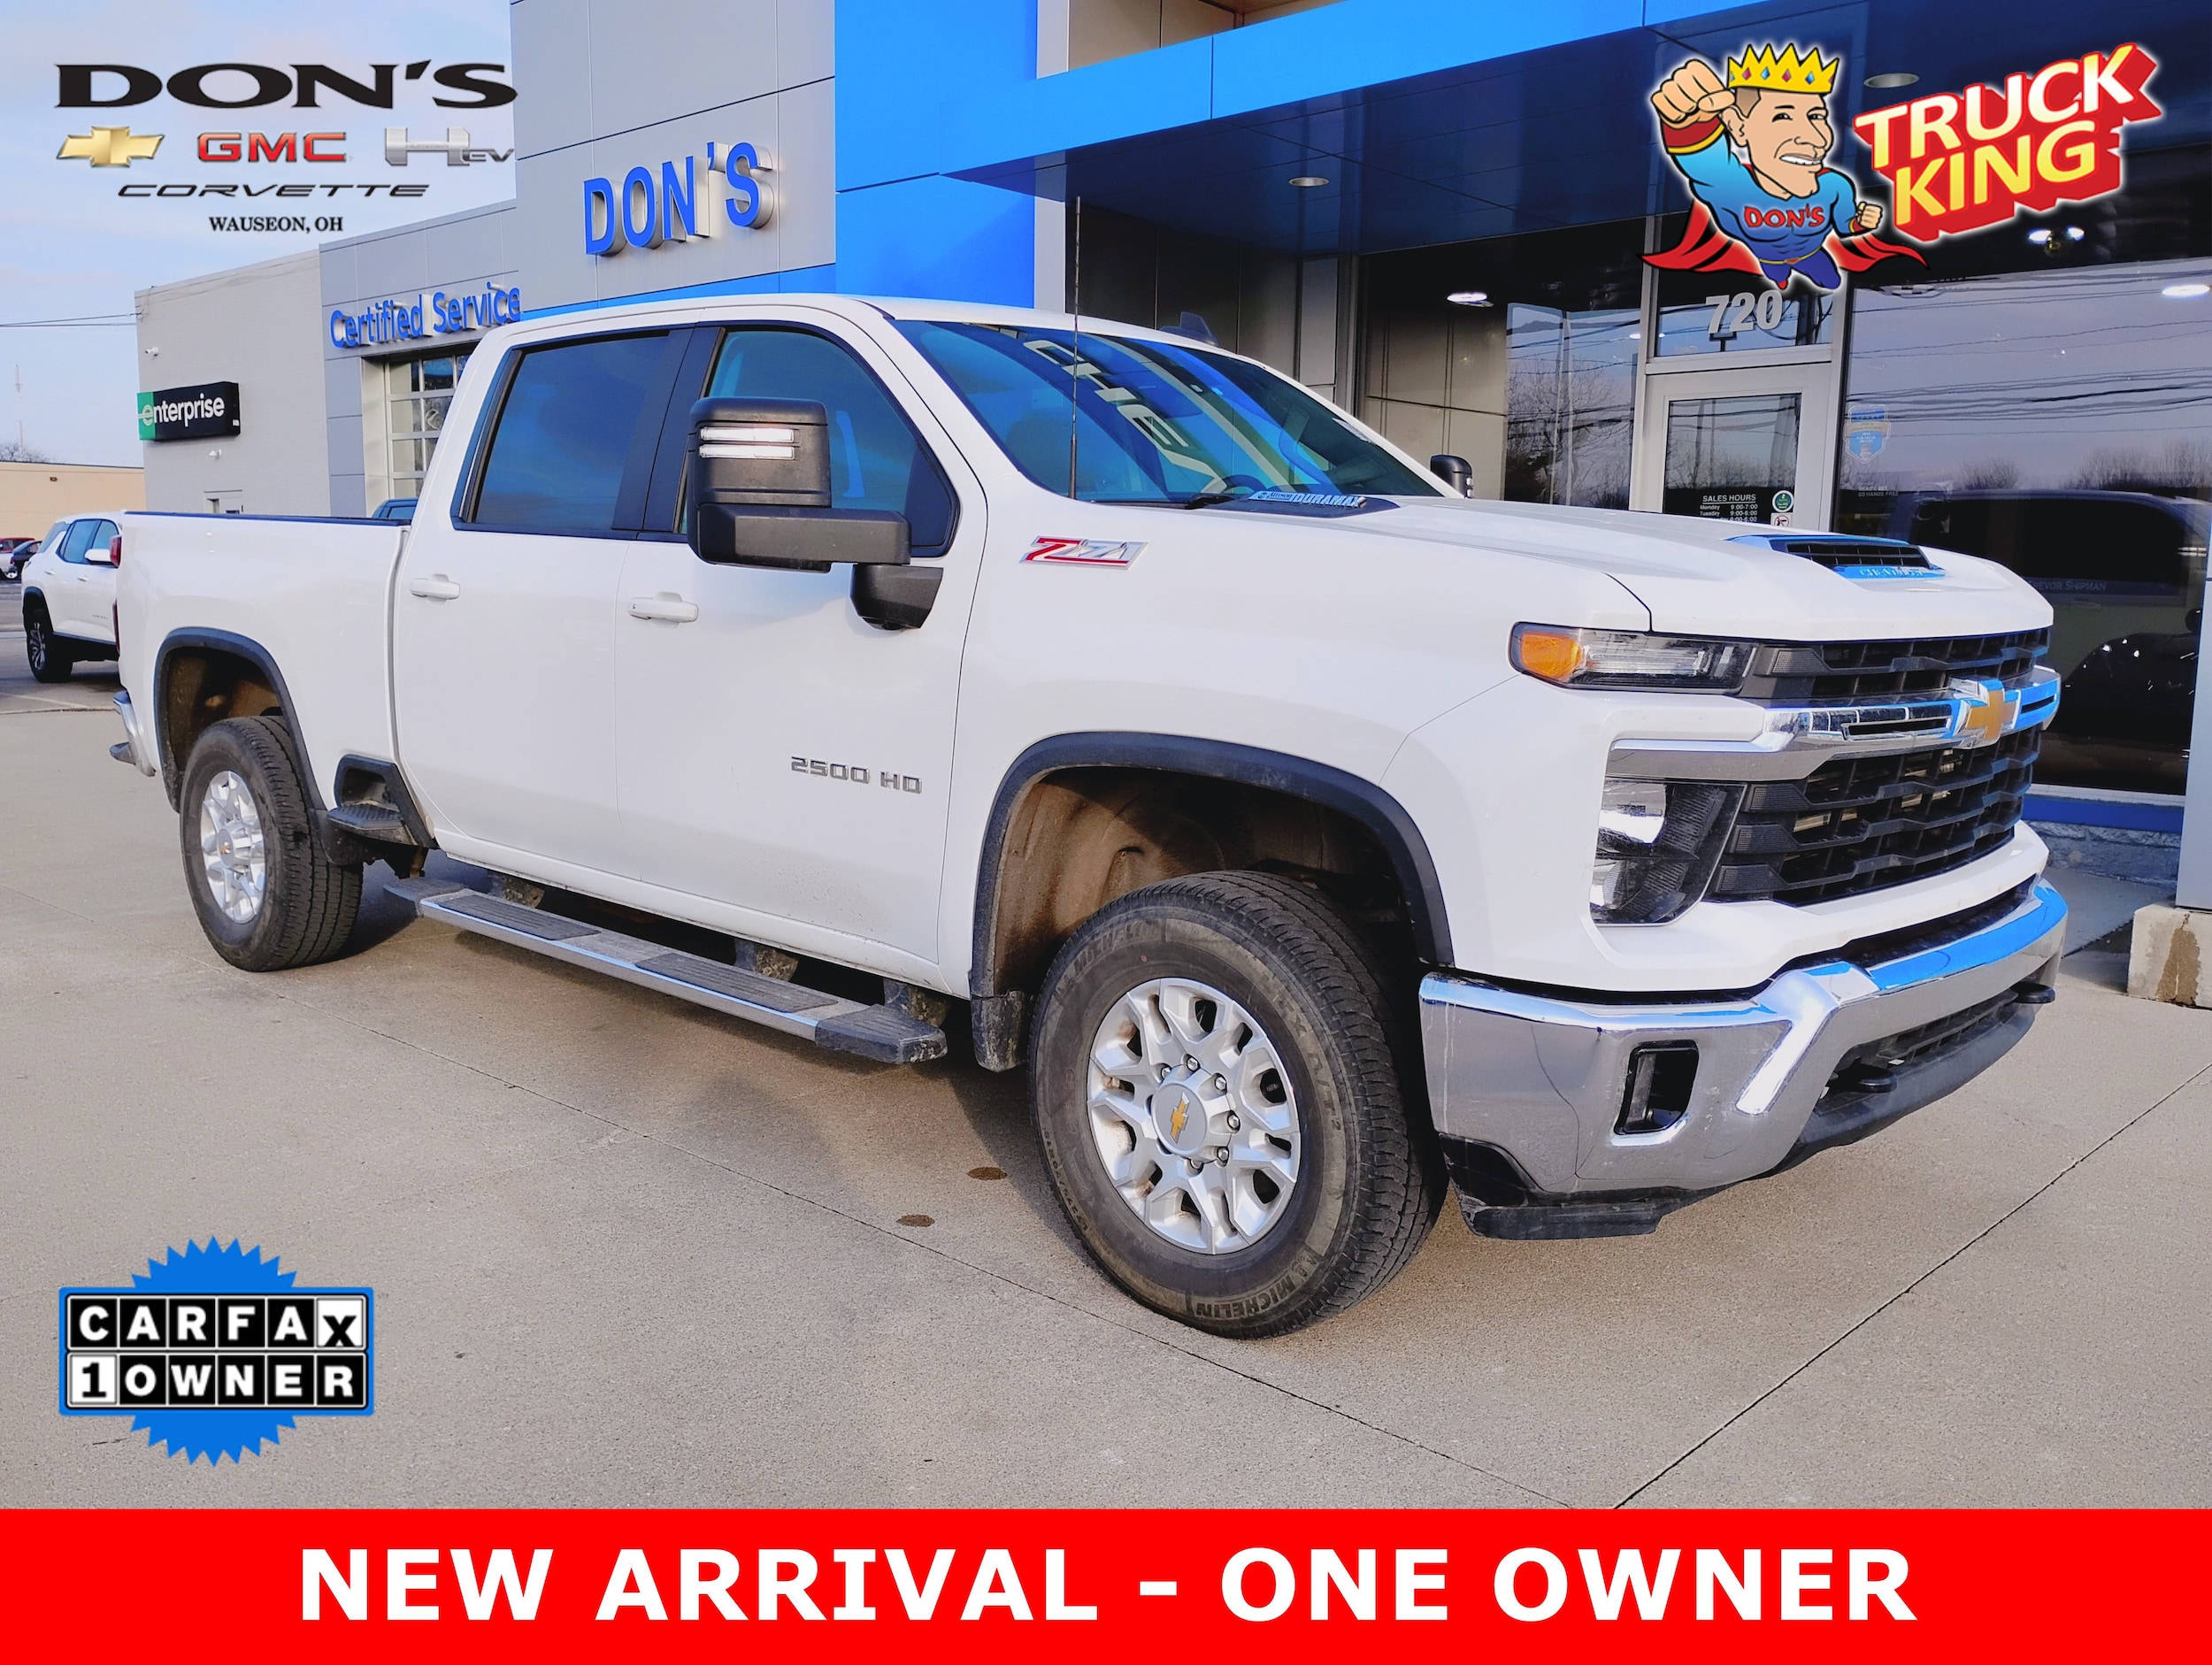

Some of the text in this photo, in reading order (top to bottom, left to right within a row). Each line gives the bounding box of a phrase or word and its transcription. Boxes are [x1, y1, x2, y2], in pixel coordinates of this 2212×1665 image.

[583, 141, 769, 257] DON'S
[330, 281, 520, 348] Certified Service
[1704, 289, 1784, 334] 720
[140, 392, 225, 427] enterprise
[1292, 493, 1363, 508] DURAMAX
[1019, 535, 1148, 571] Z71
[791, 756, 922, 794] 2500 HD
[1195, 1274, 1297, 1318] MICHELIN
